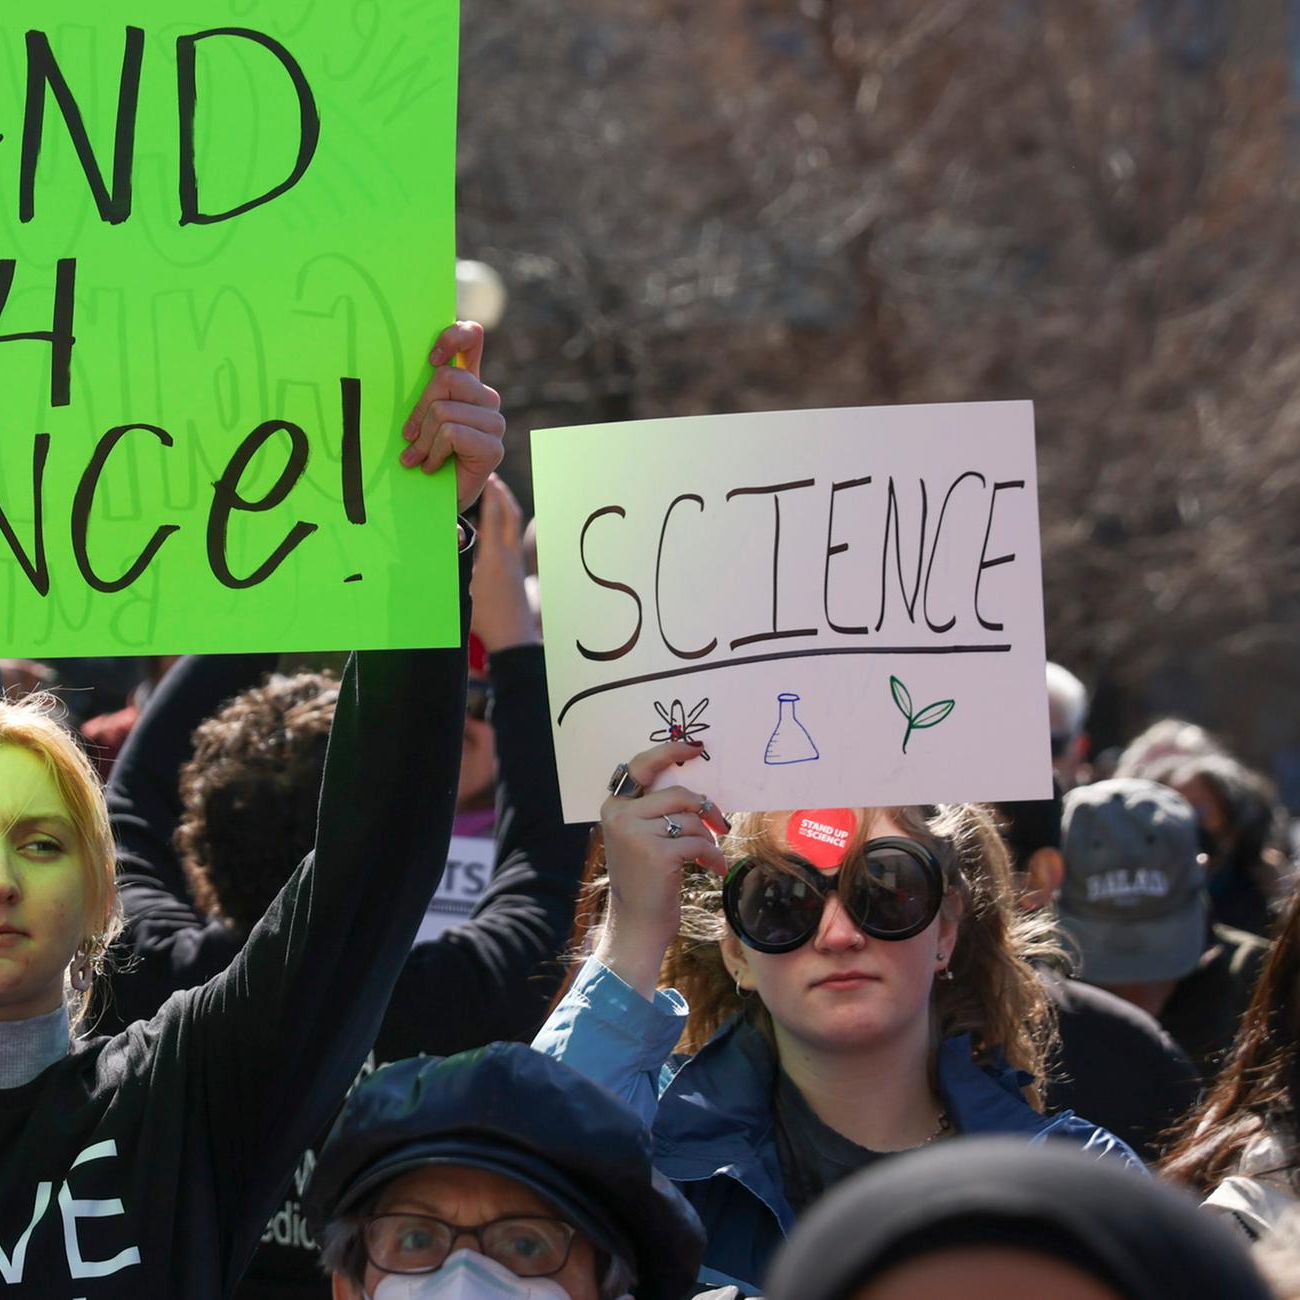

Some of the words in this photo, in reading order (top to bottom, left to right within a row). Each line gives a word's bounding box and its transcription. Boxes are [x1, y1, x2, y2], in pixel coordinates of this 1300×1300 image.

[576, 471, 1026, 662] SCIENCE
[800, 818, 834, 835] STAND
[833, 828, 849, 839] UP
[805, 829, 847, 848] SCIENCE
